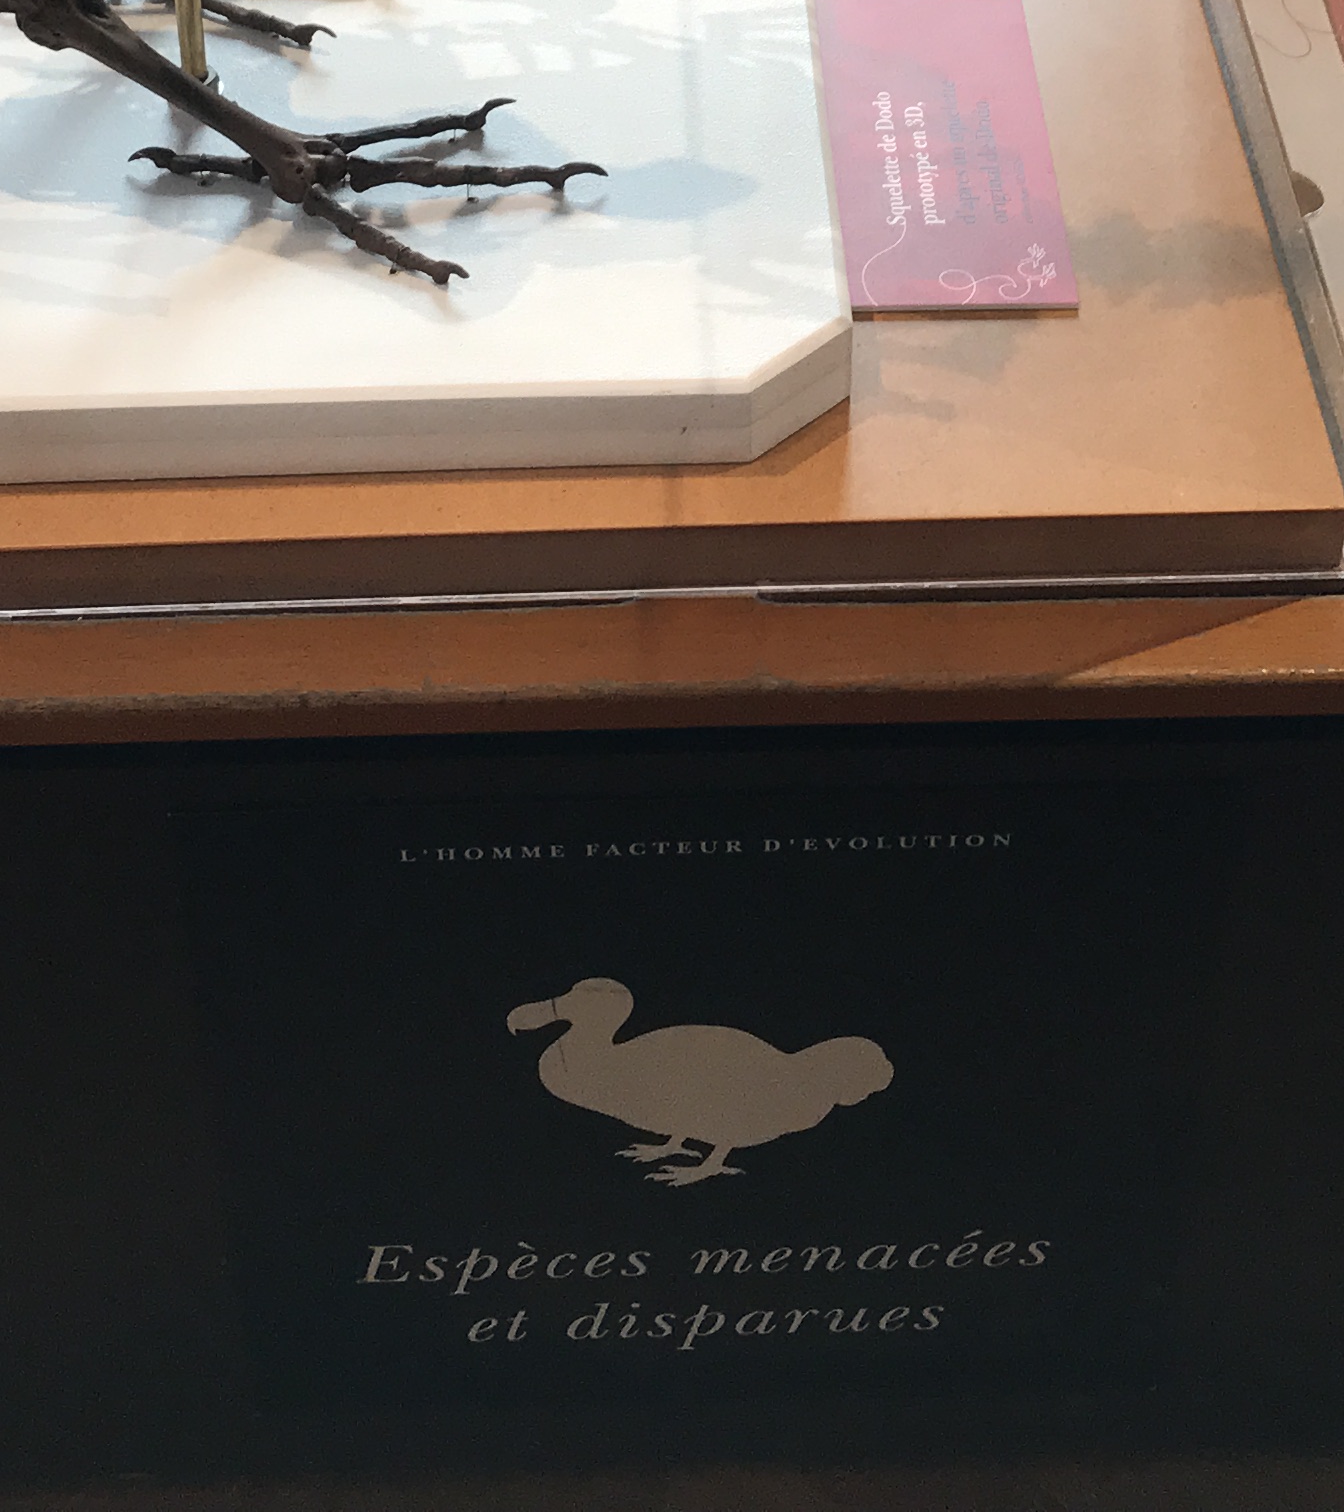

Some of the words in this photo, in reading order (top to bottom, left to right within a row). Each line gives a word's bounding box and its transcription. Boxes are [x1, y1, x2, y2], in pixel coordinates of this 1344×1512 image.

[872, 91, 894, 131] Dodo
[877, 132, 897, 153] de
[913, 131, 928, 149] en
[880, 156, 911, 226] Squelette
[915, 152, 947, 226] prototypé
[399, 844, 565, 862] L'HOMME
[585, 840, 743, 858] FACTEUR
[357, 1240, 652, 1296] Espèces
[692, 1230, 1052, 1276] menacées
[467, 1310, 529, 1343] et
[567, 1302, 946, 1351] disparues
